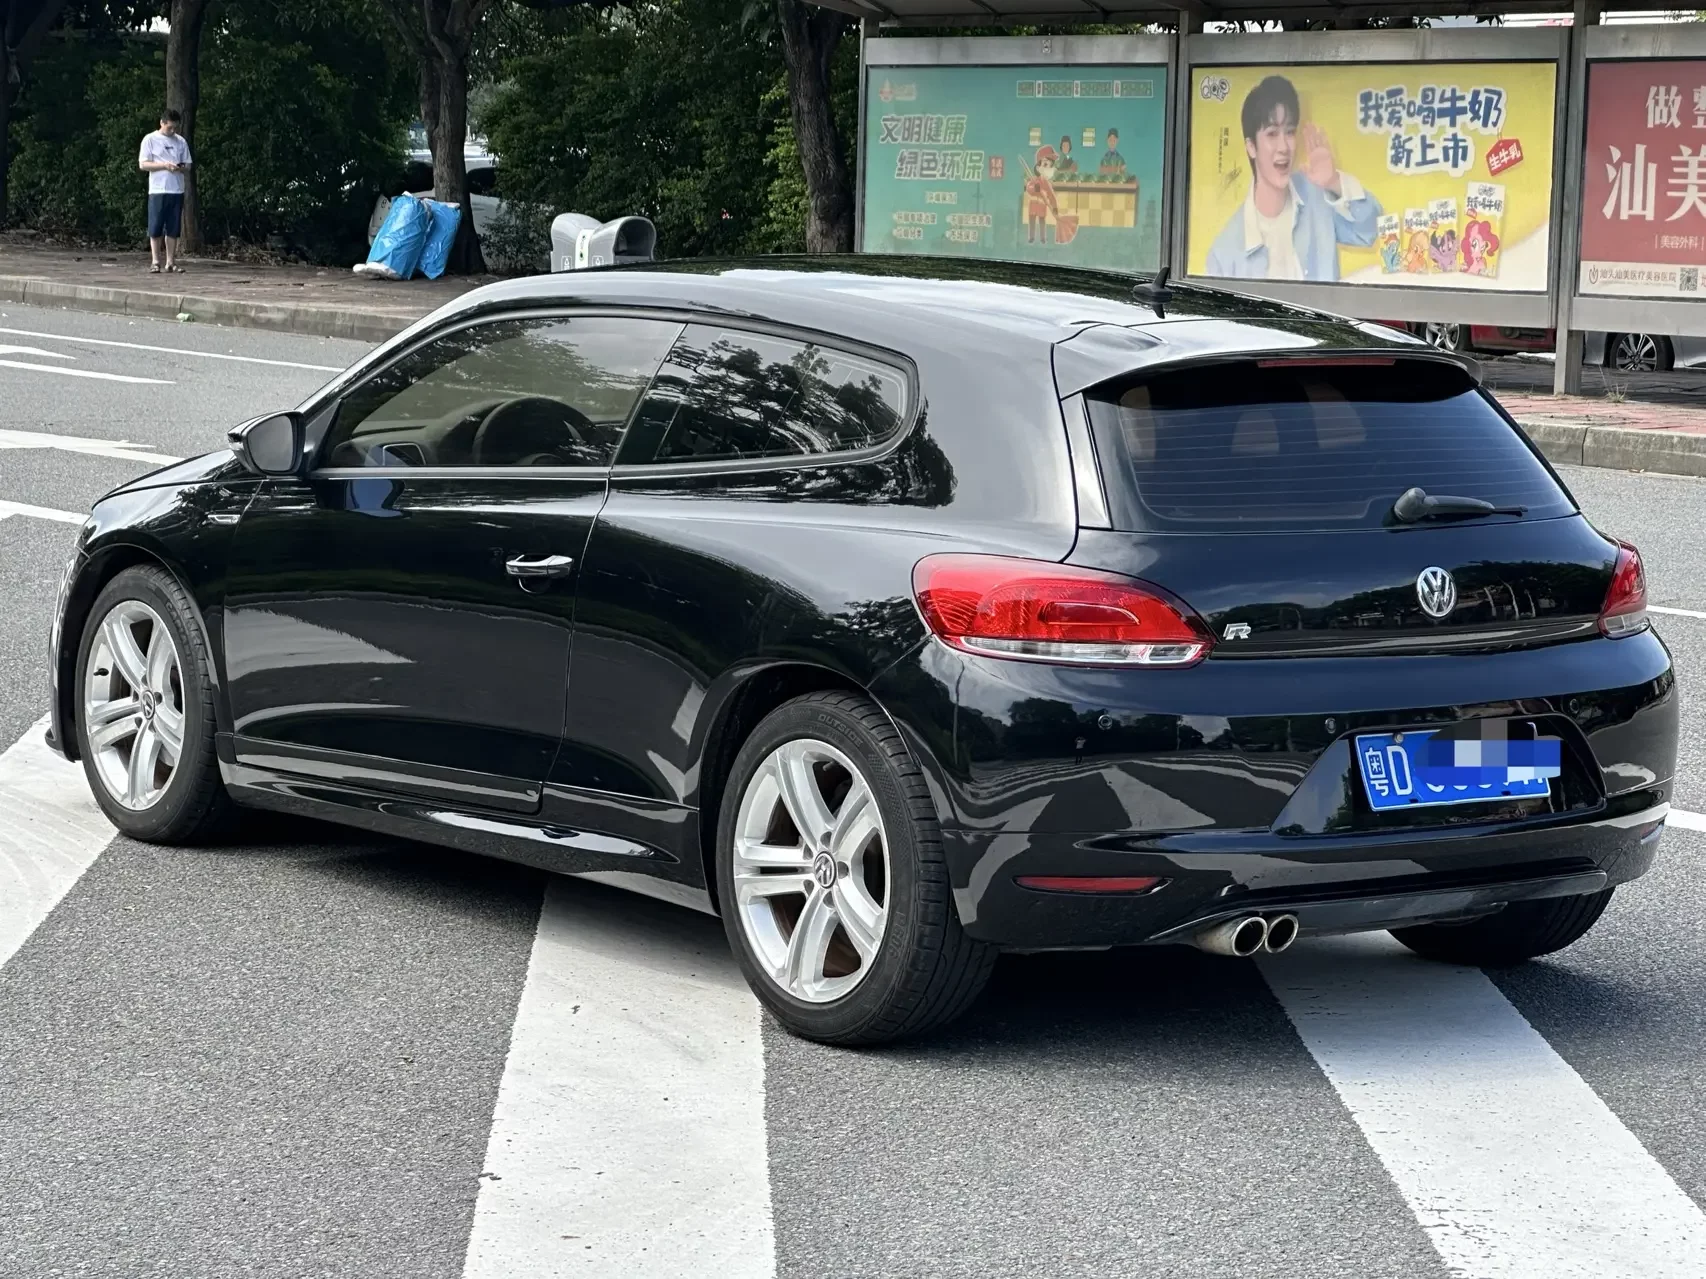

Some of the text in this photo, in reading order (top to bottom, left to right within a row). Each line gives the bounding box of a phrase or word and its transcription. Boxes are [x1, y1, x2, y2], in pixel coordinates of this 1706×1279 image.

[1359, 87, 1503, 129] 我爱喝牛奶
[880, 114, 967, 144] 文明健康
[895, 149, 984, 181] 绿色环保
[1390, 132, 1469, 169] 新上市
[1488, 142, 1522, 171] 生牛乳
[1602, 143, 1706, 222] 汕美
[1661, 234, 1699, 250] 美容外科
[818, 714, 864, 748] OUTSIDE
